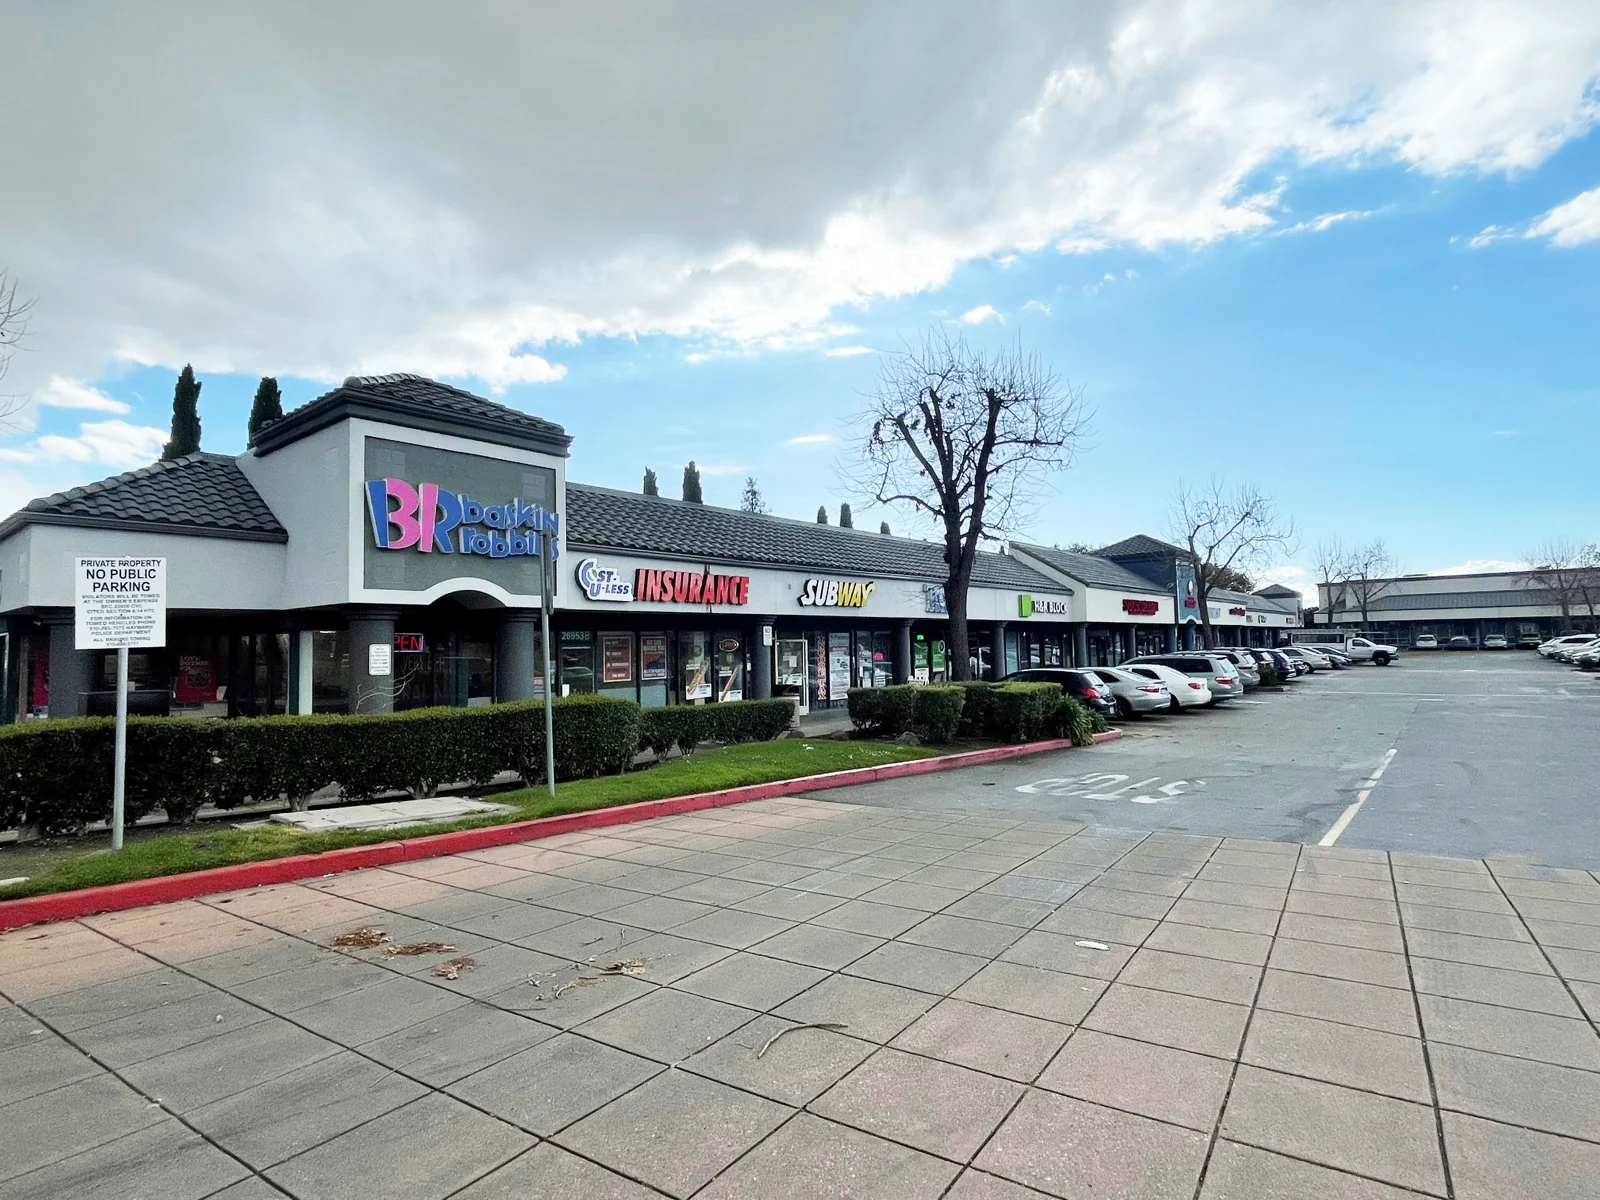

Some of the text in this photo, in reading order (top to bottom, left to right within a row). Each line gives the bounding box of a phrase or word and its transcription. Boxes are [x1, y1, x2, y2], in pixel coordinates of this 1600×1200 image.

[365, 476, 463, 554] BR
[458, 527, 560, 562] robbis
[80, 559, 161, 567] PRIVATE PROPERTY
[86, 568, 156, 580] NO PUBLIC
[93, 581, 150, 592] PARKING
[590, 583, 629, 597] U-LESS
[636, 568, 750, 605] INSURANCE
[799, 578, 876, 608] SUBWAY
[1033, 600, 1068, 614] H&R BLOCK
[394, 635, 422, 650] PEN
